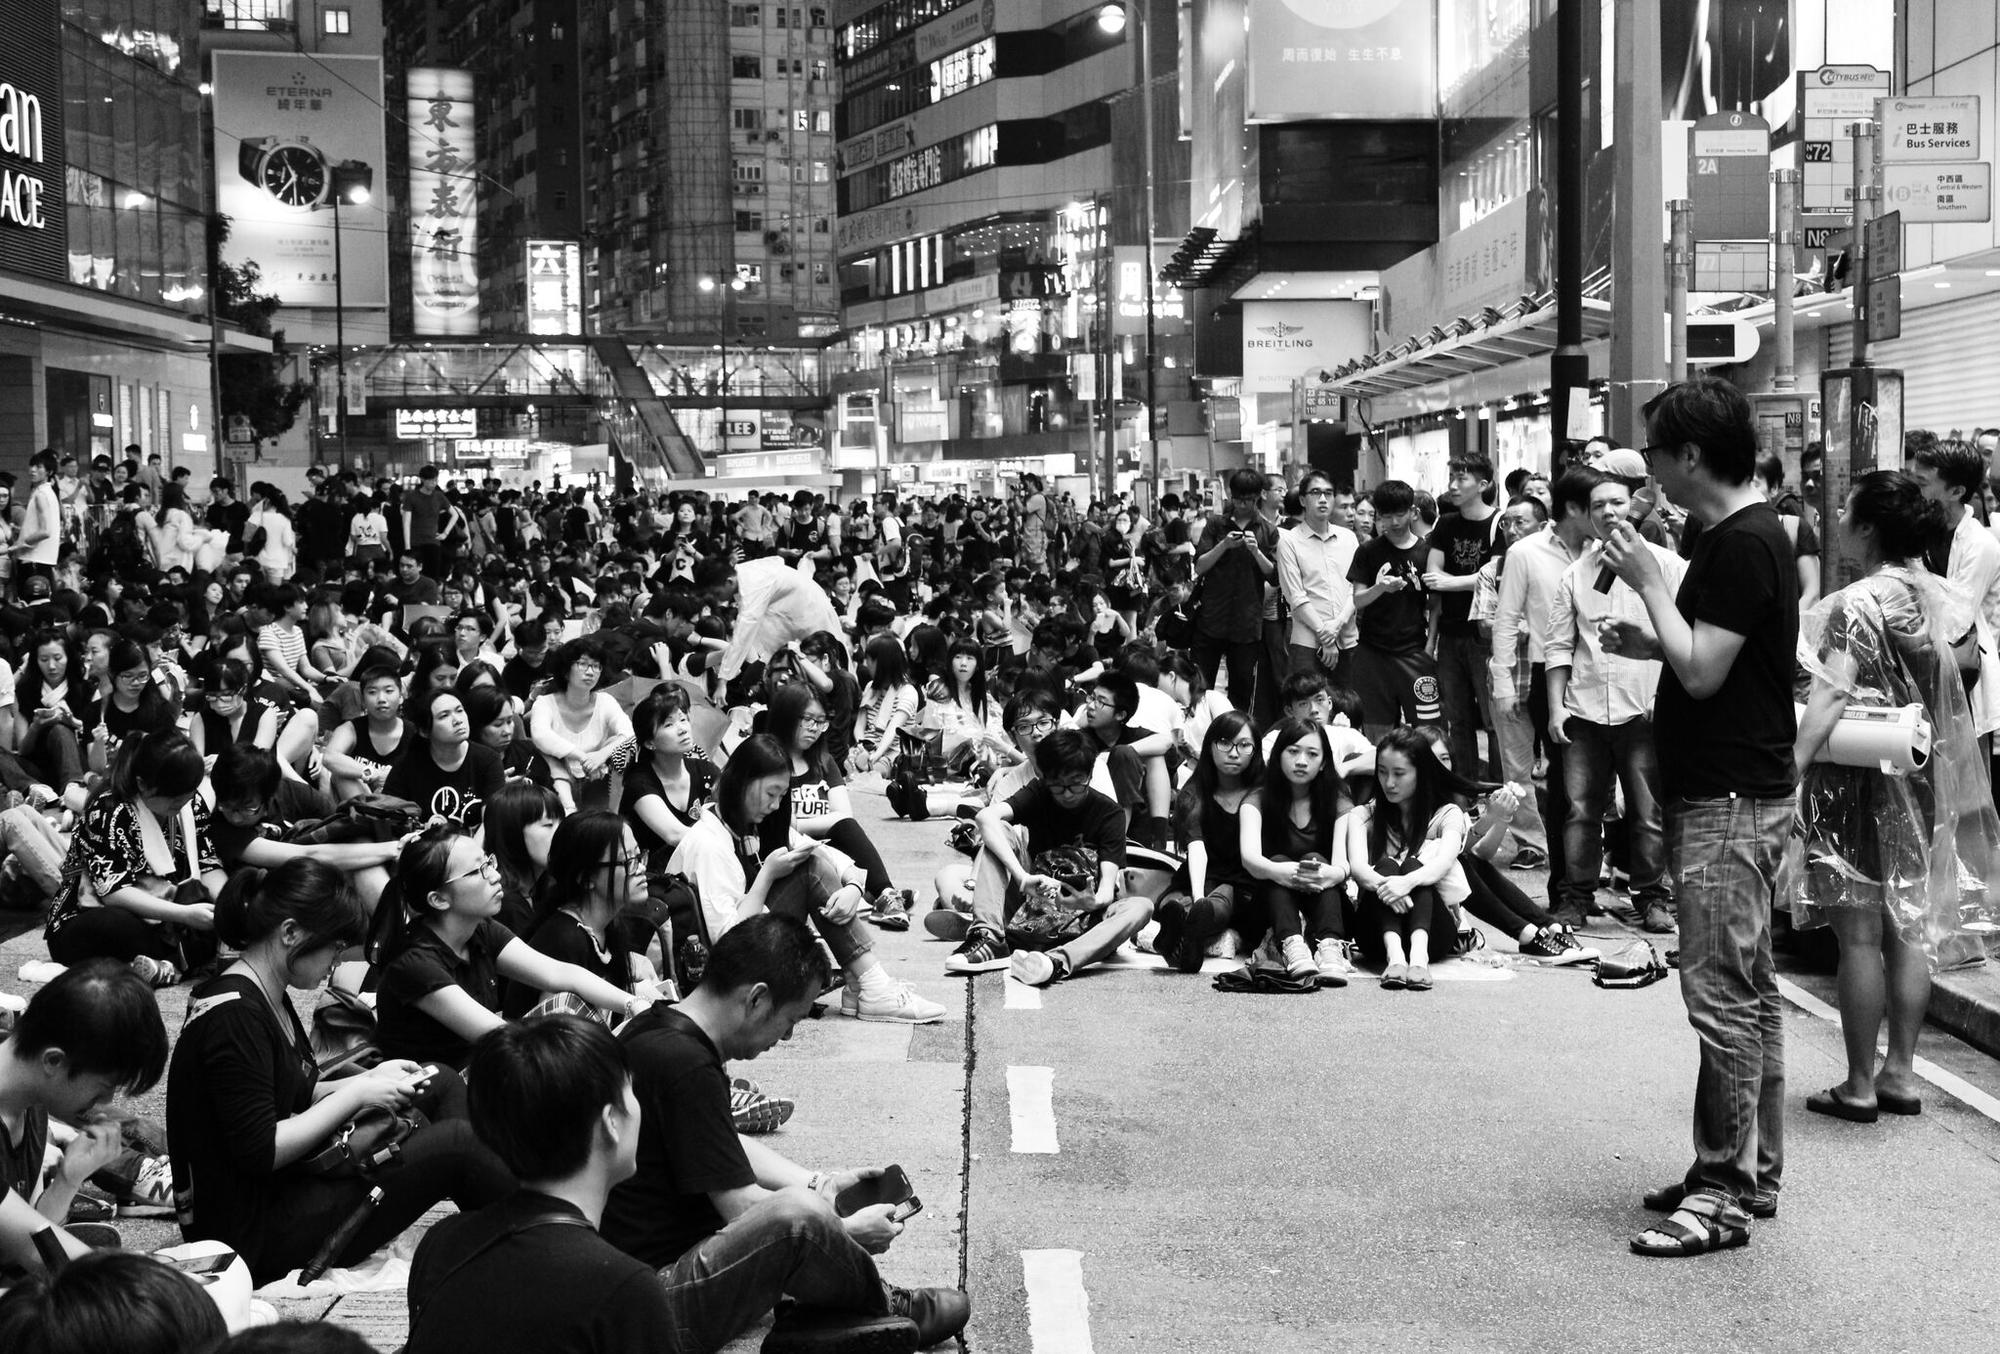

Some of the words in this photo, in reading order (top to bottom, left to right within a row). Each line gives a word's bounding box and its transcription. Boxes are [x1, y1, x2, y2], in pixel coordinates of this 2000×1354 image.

[1347, 47, 1403, 62] 生生不息
[265, 86, 333, 98] ETERNA
[1906, 122, 1959, 135] 巴士服務
[1906, 139, 1926, 149] Bus
[1928, 138, 1971, 148] Services
[1697, 158, 1718, 175] 2A
[423, 91, 463, 263] 東方表行
[1937, 174, 1963, 183] 中西區
[0, 169, 46, 229] ACE
[1937, 194, 1954, 203] 南區
[1247, 339, 1313, 349] BREITLING
[1786, 413, 1802, 424] N8
[675, 558, 686, 571] C
